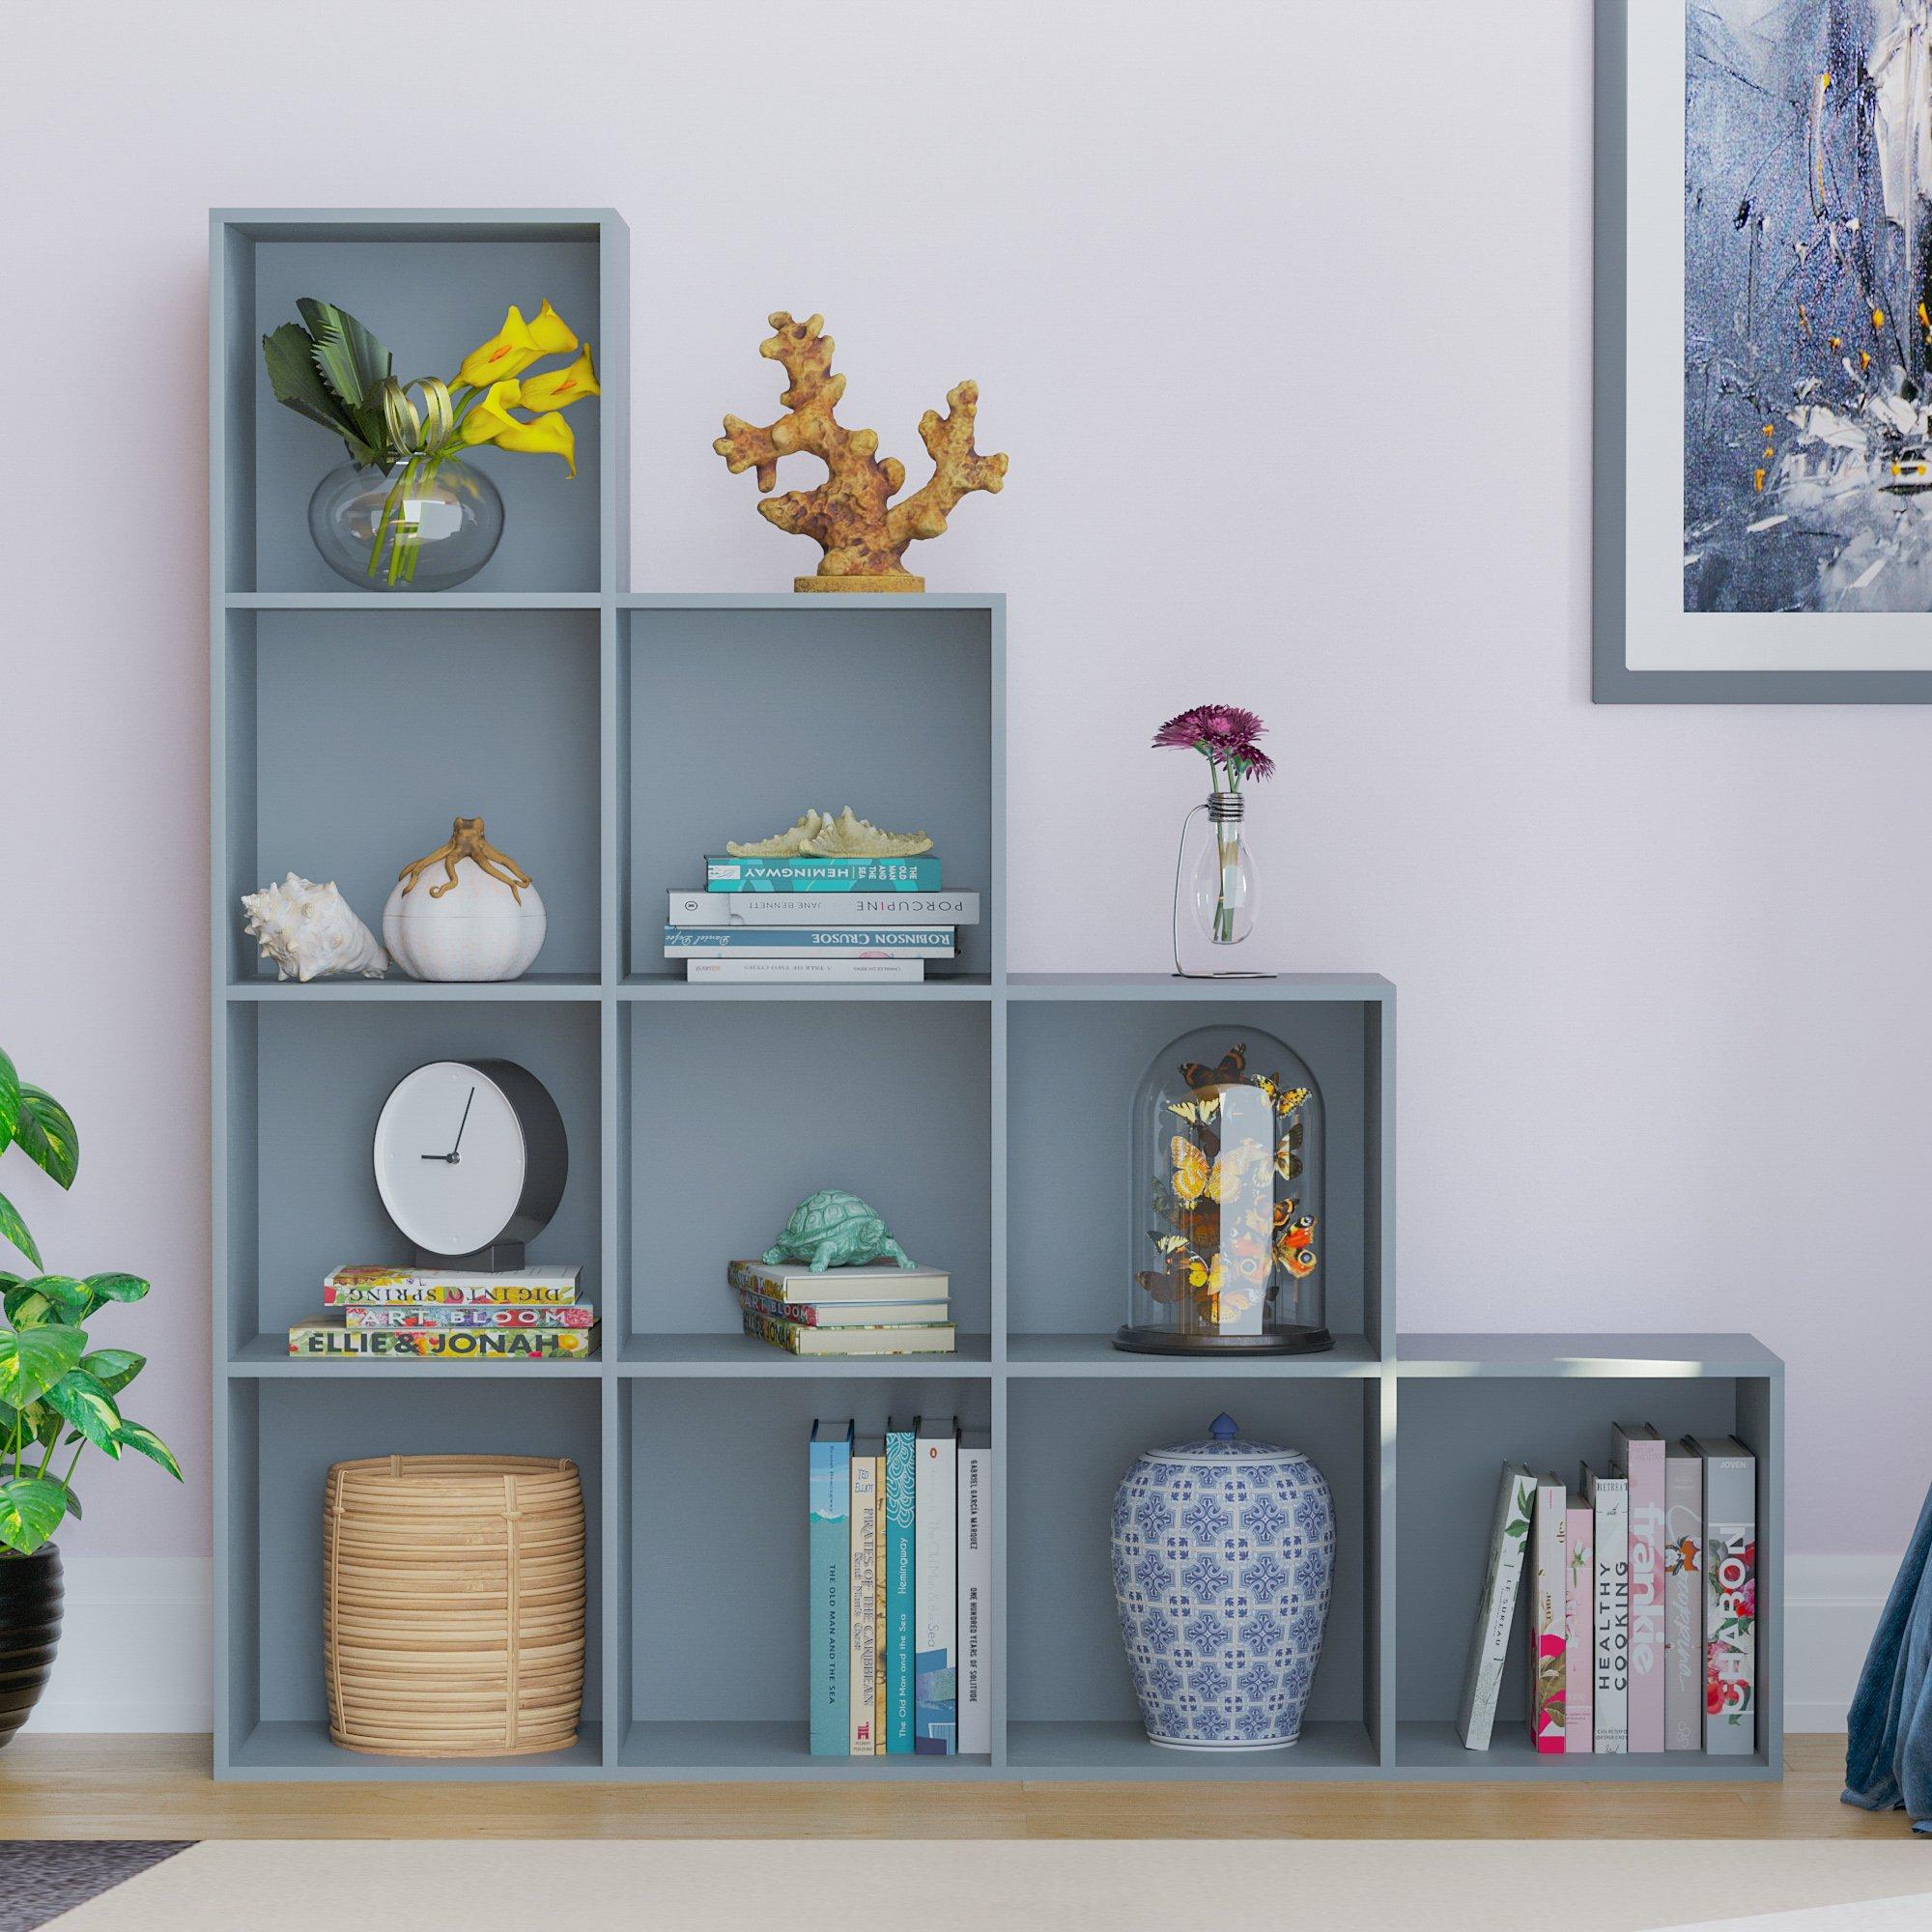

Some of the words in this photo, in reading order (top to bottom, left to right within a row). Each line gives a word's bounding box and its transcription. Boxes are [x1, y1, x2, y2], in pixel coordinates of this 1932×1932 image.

[744, 867, 849, 878] HEMINGWAY
[858, 867, 867, 879] SEA
[868, 867, 877, 879] THE
[878, 866, 887, 880] AND
[898, 866, 907, 880] OLD
[909, 867, 918, 880] THE
[856, 900, 963, 911] PORCUPINE
[693, 935, 731, 946] Daniel
[812, 933, 869, 945] CRUSOE
[875, 933, 951, 945] ROBINSON
[348, 1288, 437, 1302] SPRING
[449, 1288, 510, 1301] INTO
[519, 1289, 560, 1301] DIG
[744, 1294, 766, 1311] ART
[771, 1302, 809, 1321] BLOOM
[360, 1310, 430, 1324] ART
[450, 1311, 567, 1324] BLOOM
[308, 1332, 387, 1352] ELLIE
[394, 1333, 419, 1353] &
[431, 1333, 559, 1353] JONAH
[1597, 1483, 1628, 1492] RETREAT
[861, 1508, 874, 1566] PIRATES
[898, 1538, 908, 1594] Hemingway
[861, 1568, 874, 1588] OF
[1632, 1502, 1664, 1676] frankie
[863, 1596, 874, 1621] THE
[1599, 1562, 1610, 1690] HEALTHY
[1615, 1561, 1628, 1690] COOKING
[1719, 1526, 1746, 1713] CHABON
[927, 1623, 940, 1648] Sea
[861, 1625, 874, 1708] CARIBBEAN
[970, 1660, 977, 1669] OF
